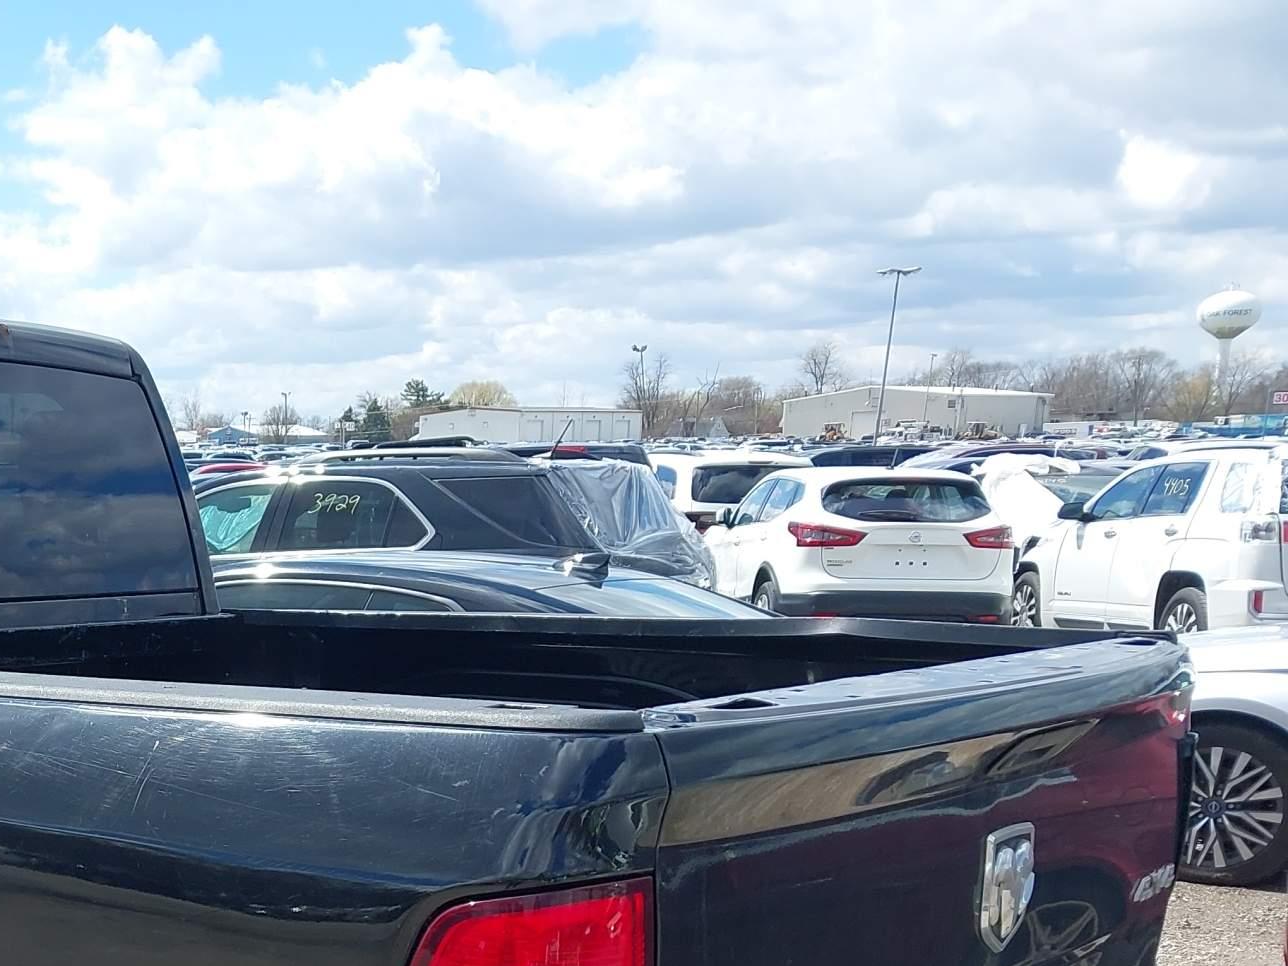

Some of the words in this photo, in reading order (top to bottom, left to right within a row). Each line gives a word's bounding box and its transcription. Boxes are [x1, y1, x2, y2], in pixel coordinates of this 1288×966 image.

[1223, 308, 1252, 316] FOREST
[1164, 476, 1191, 496] 4405
[307, 493, 361, 515] 3929
